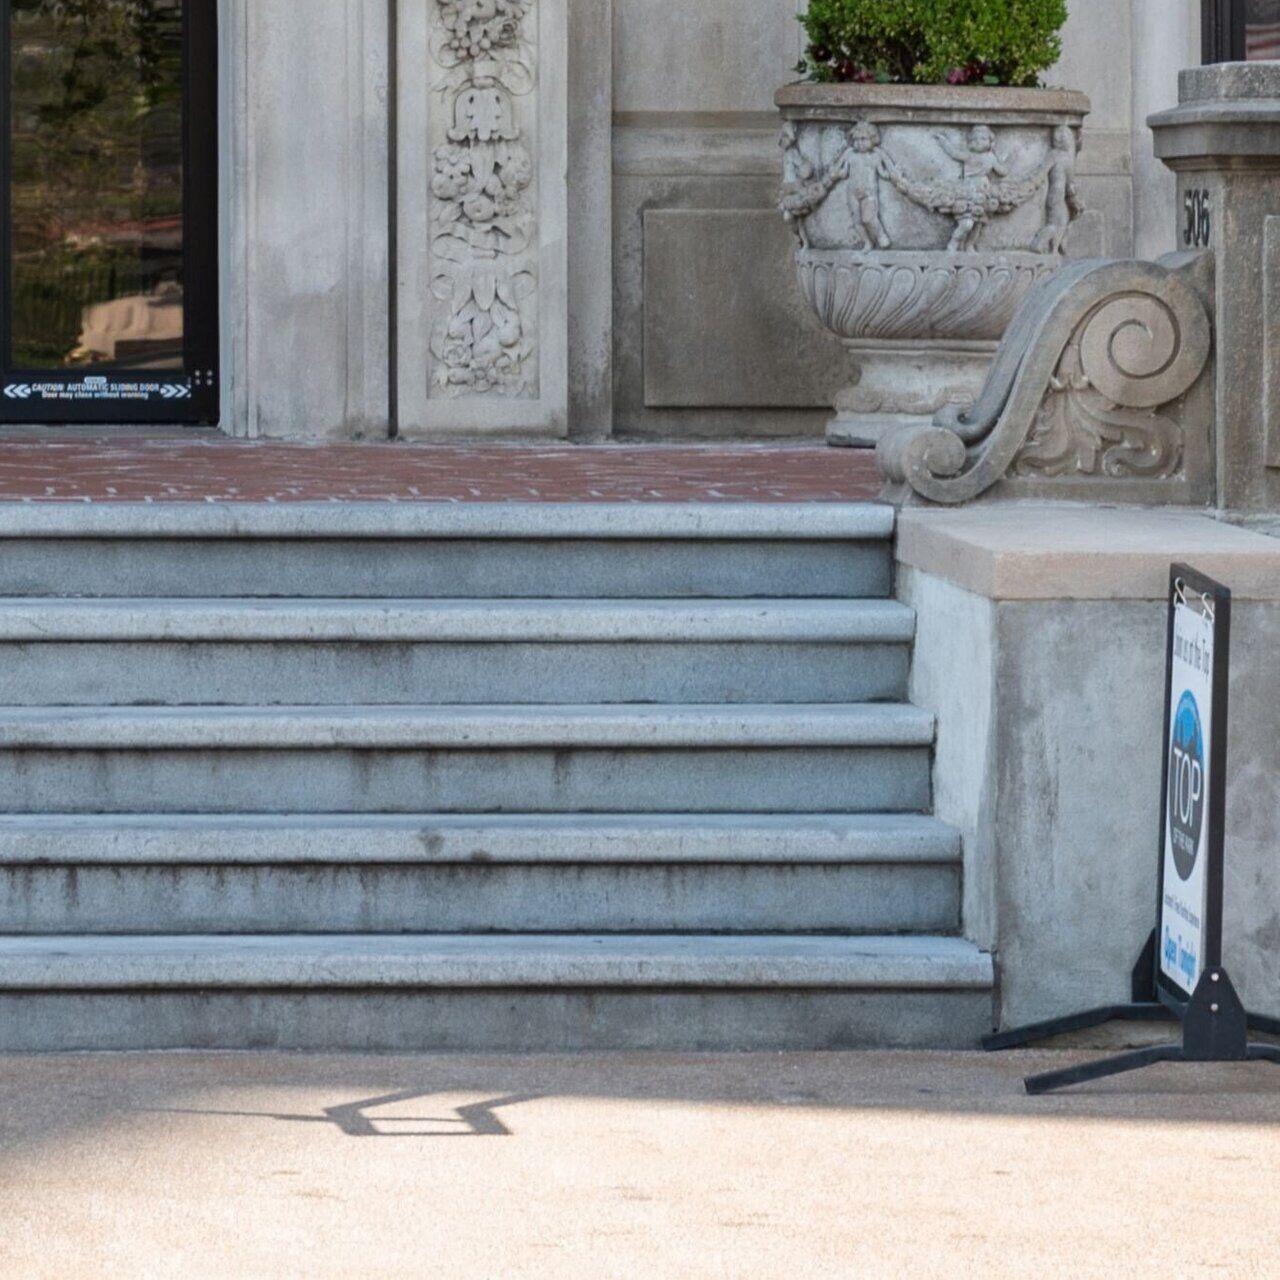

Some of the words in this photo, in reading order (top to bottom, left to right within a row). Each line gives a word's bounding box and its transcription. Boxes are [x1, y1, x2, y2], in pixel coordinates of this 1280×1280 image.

[1184, 189, 1210, 247] 506
[67, 382, 109, 392] AUTOMATIC
[1174, 746, 1201, 828] TOP
